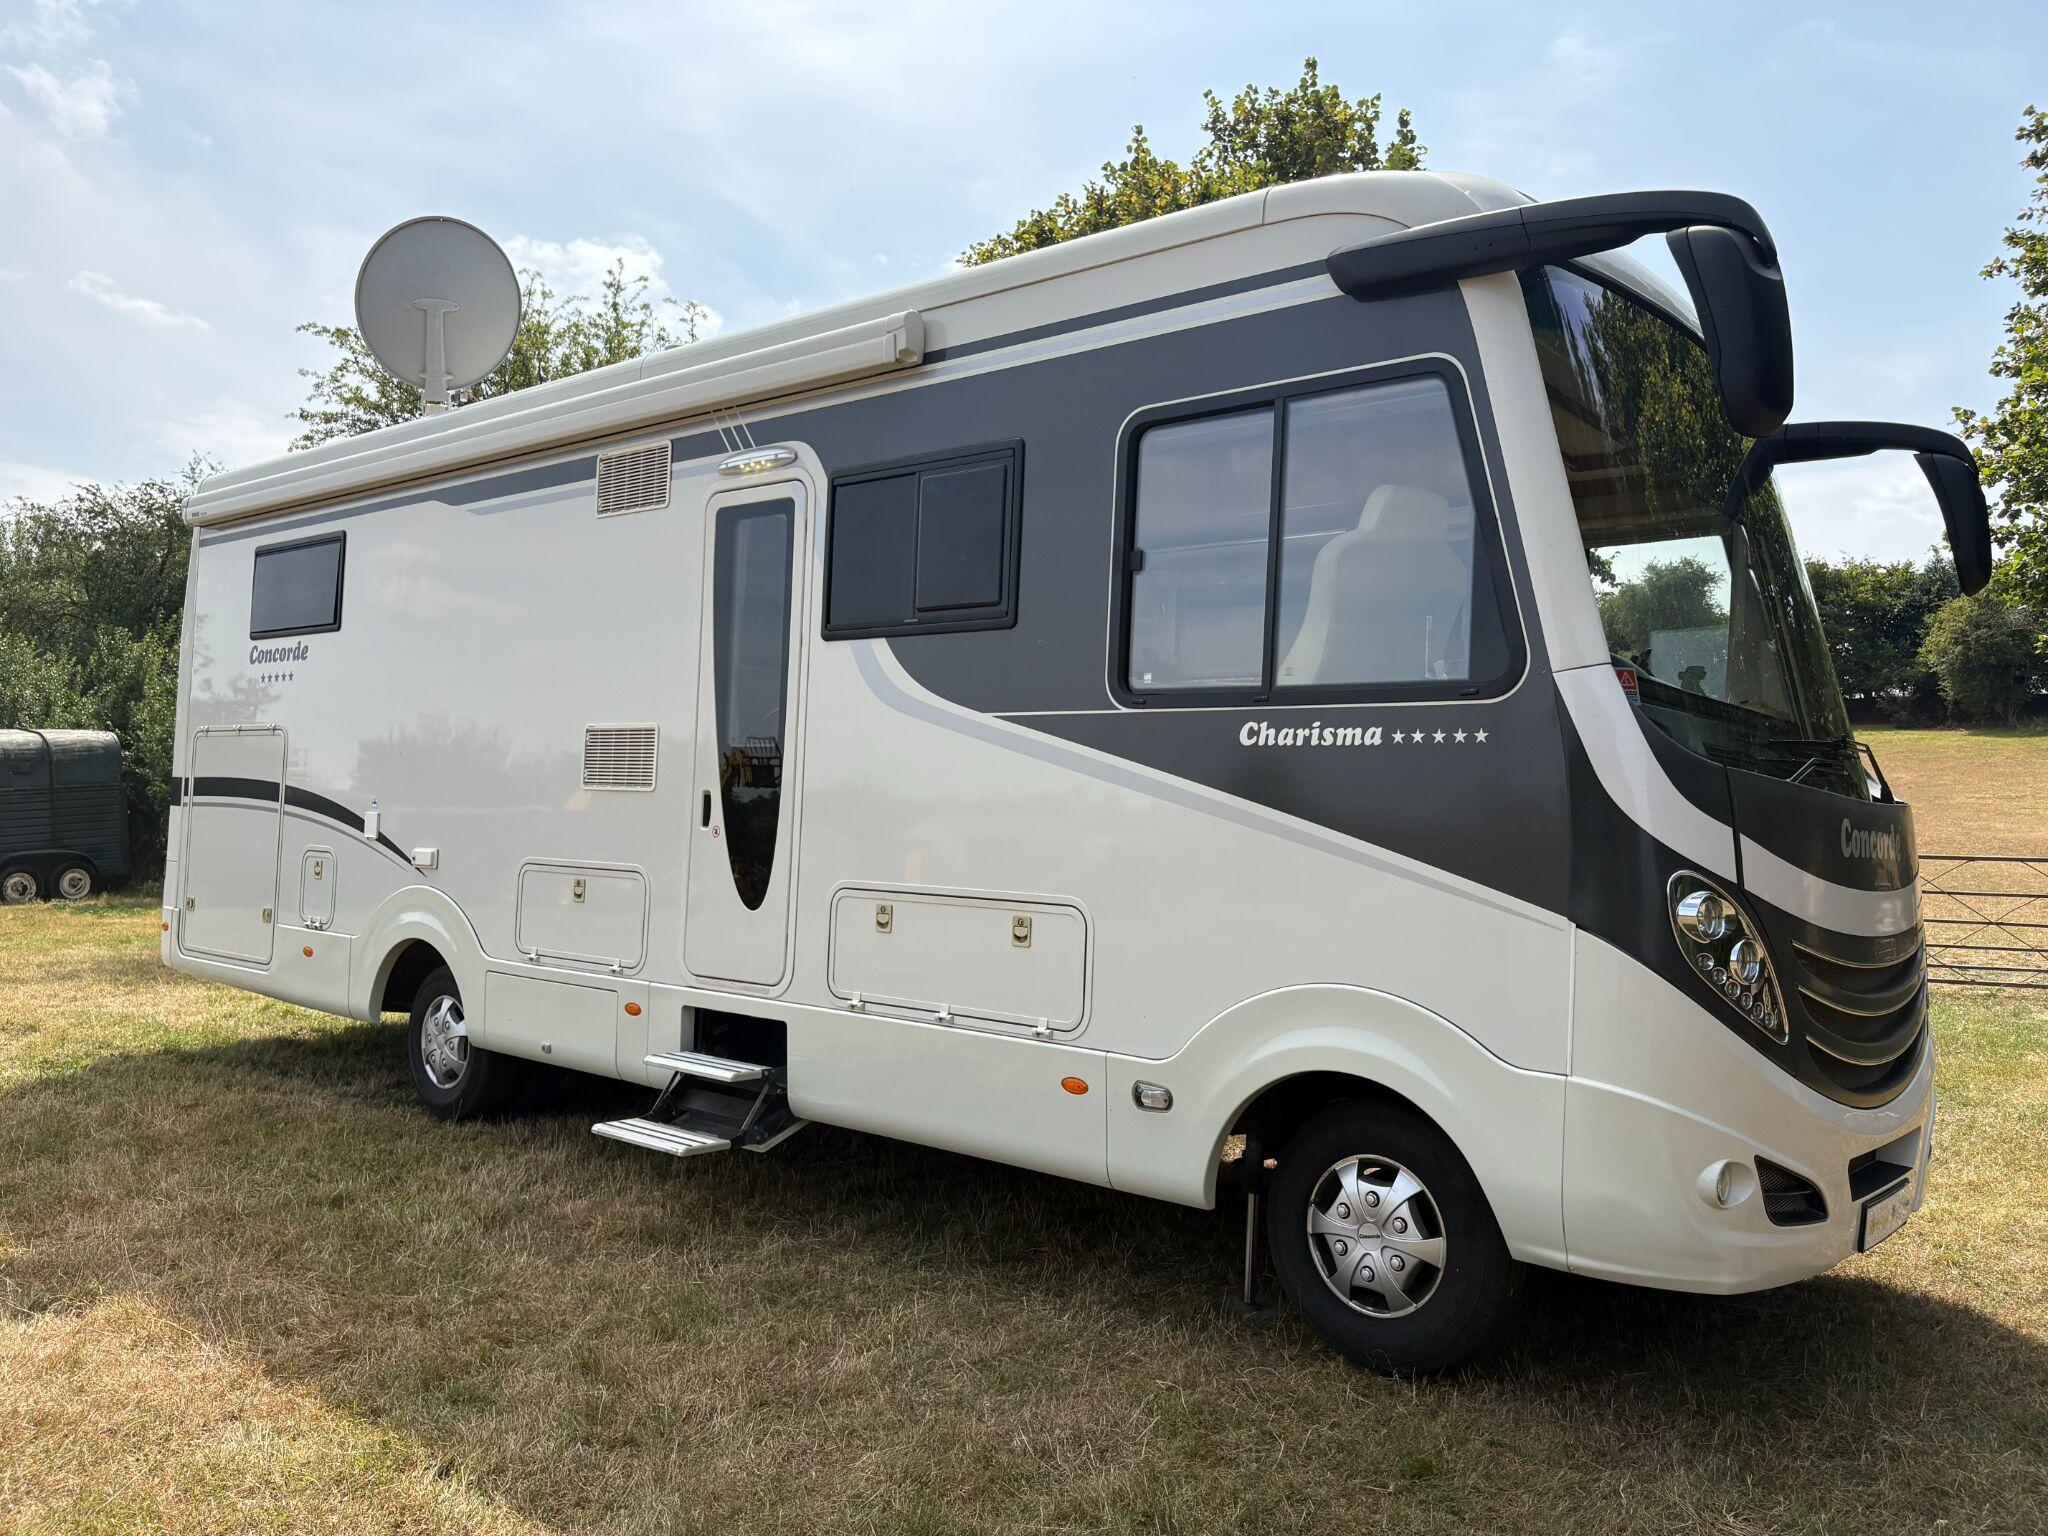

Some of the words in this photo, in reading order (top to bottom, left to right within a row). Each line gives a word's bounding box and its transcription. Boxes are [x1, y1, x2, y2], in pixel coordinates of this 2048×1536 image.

[249, 641, 309, 665] Concorde
[1239, 721, 1383, 746] Charisma
[1841, 818, 1902, 860] Concorde
